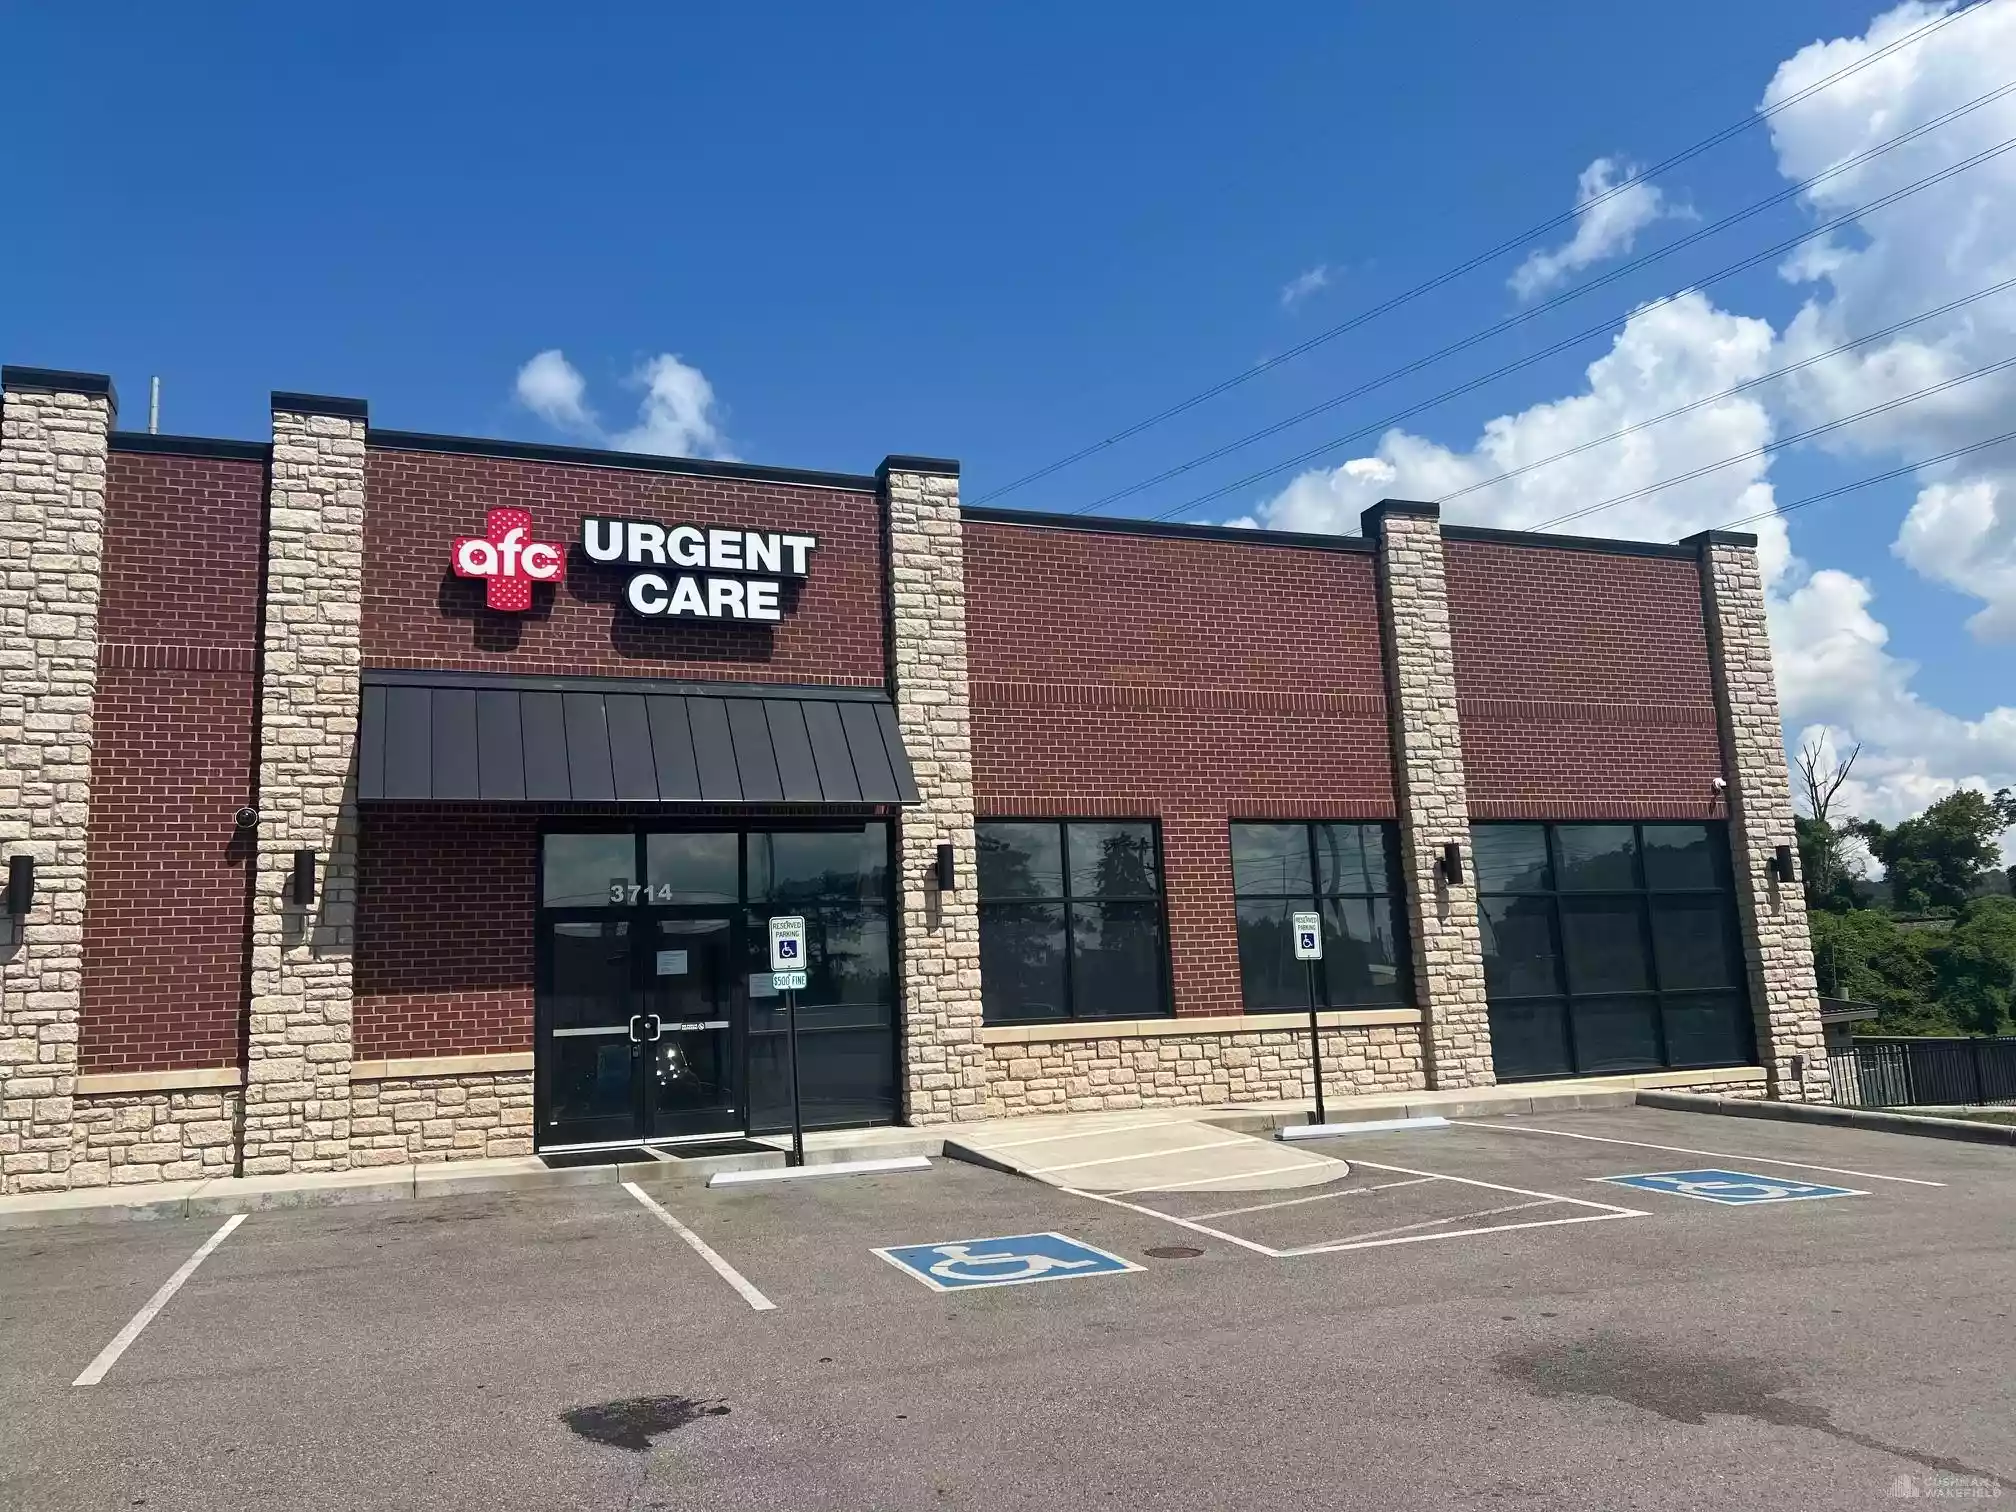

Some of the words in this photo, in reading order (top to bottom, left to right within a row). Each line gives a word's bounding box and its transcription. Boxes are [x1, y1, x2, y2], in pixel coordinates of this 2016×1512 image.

[458, 527, 559, 579] afc
[584, 519, 816, 575] URGENT
[628, 573, 780, 620] CARE
[610, 883, 673, 903] 3714
[772, 921, 802, 930] RESERVED
[773, 975, 790, 986] $500
[791, 975, 806, 986] FINE
